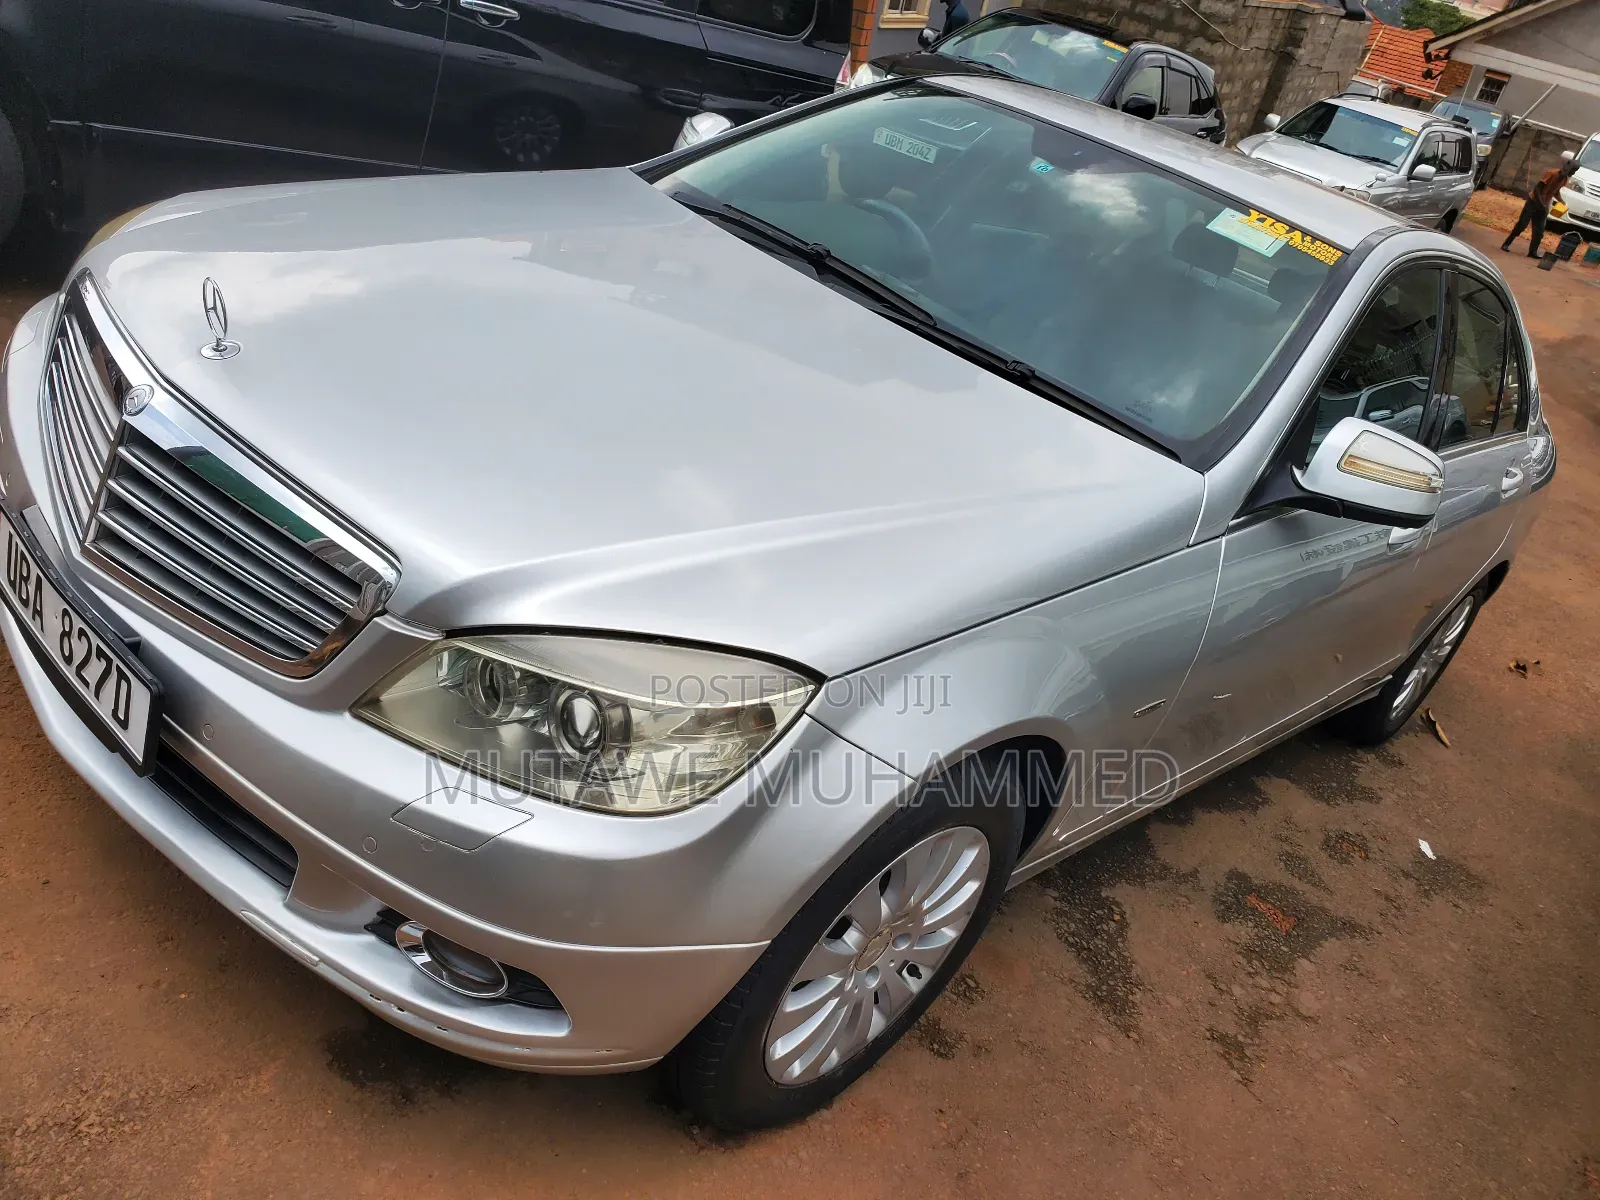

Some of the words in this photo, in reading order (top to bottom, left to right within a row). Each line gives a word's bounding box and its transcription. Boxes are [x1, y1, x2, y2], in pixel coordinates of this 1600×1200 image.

[885, 133, 904, 150] UBM
[906, 141, 931, 160] 204Z
[1248, 208, 1303, 244] YISA
[1303, 240, 1338, 261] MOTORS
[1314, 240, 1343, 257] SONS
[7, 530, 44, 634] UBA
[59, 607, 132, 731] 827D
